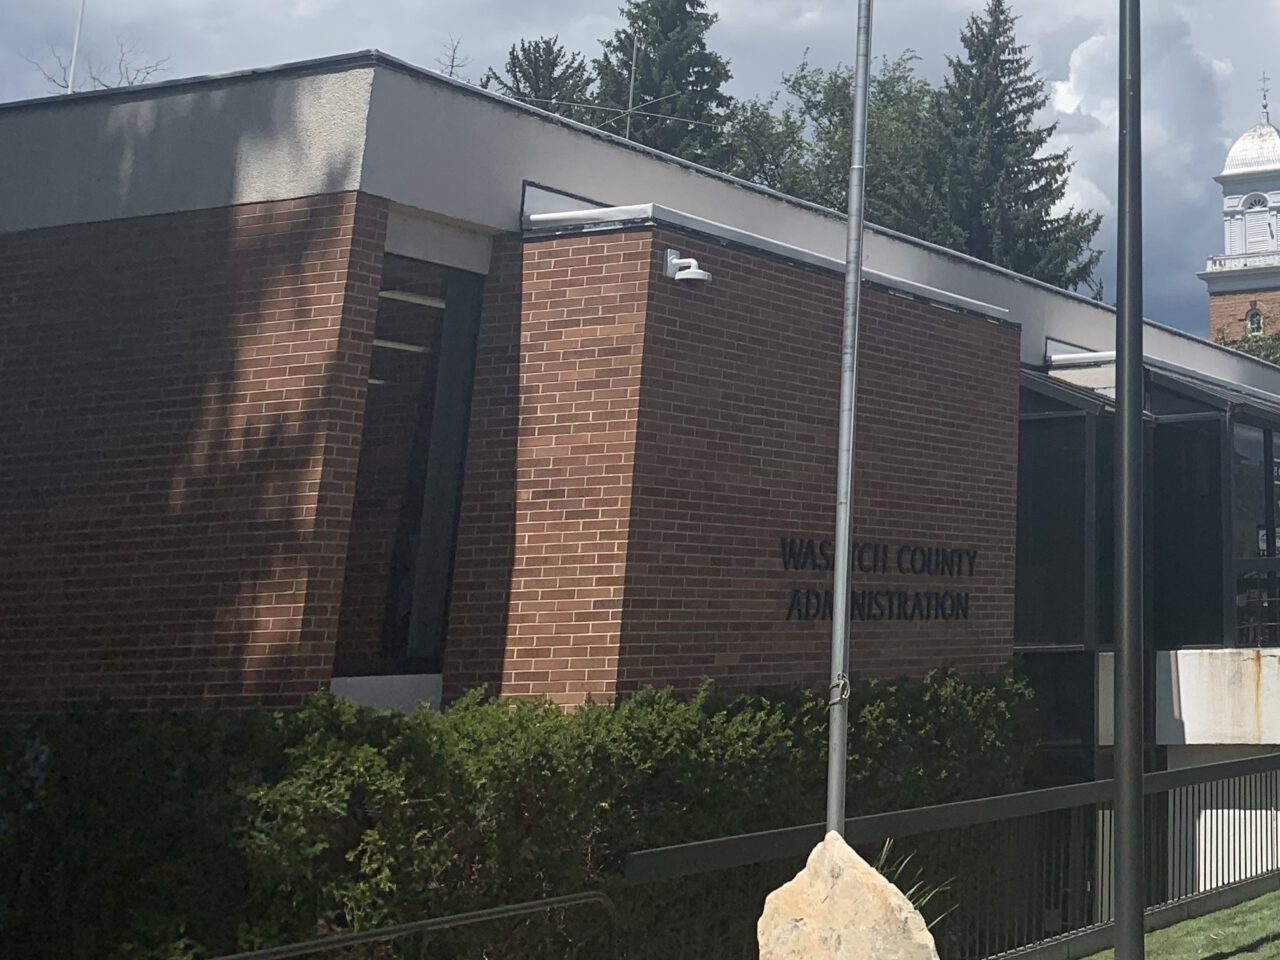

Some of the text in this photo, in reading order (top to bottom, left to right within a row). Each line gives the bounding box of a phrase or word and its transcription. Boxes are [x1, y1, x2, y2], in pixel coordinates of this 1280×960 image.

[782, 538, 977, 576] WASTCH COUNTY
[787, 590, 969, 620] ADMNISTRATION
